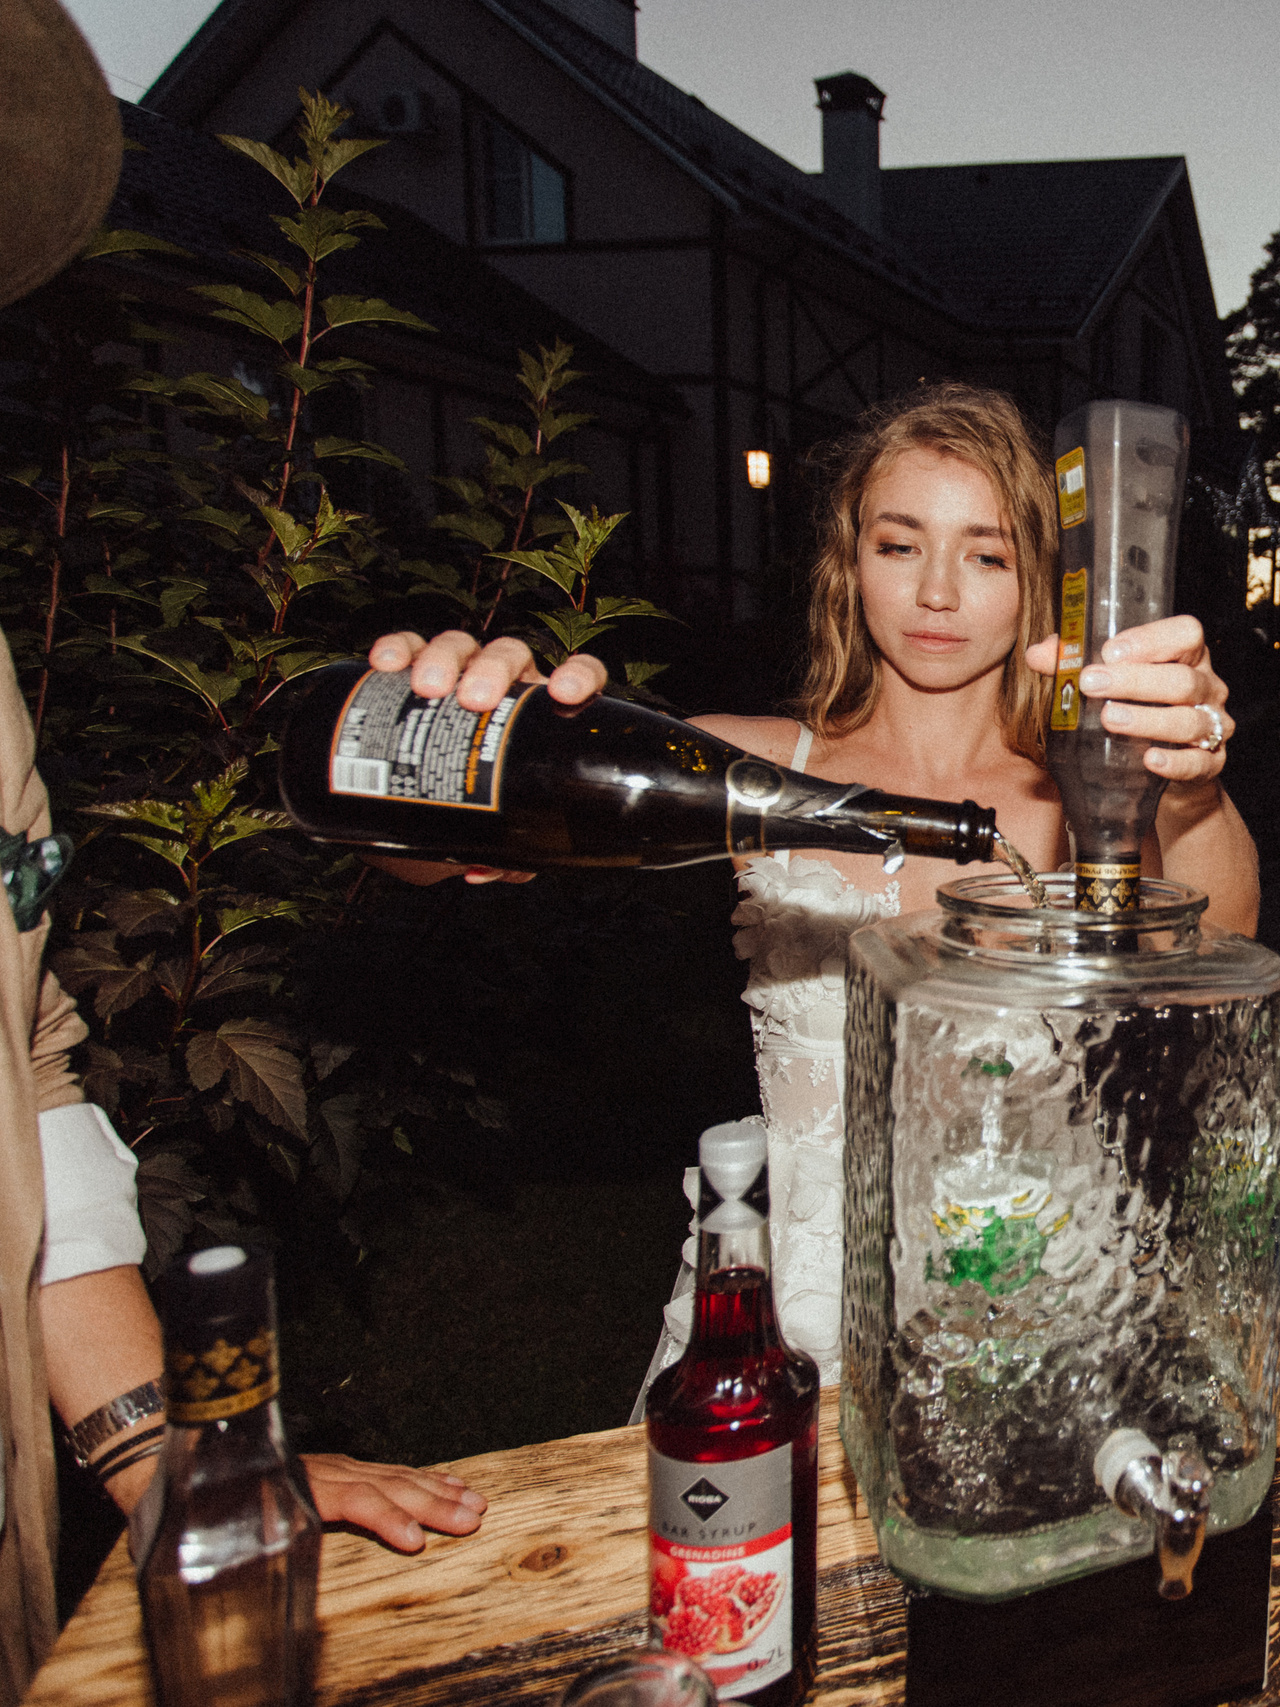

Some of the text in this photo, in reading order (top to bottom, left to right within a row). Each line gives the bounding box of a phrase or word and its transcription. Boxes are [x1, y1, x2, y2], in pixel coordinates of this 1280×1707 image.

[687, 1494, 722, 1504] RIOBA
[661, 1522, 757, 1540] BAR SYRUP
[669, 1545, 746, 1561] GRENADINE
